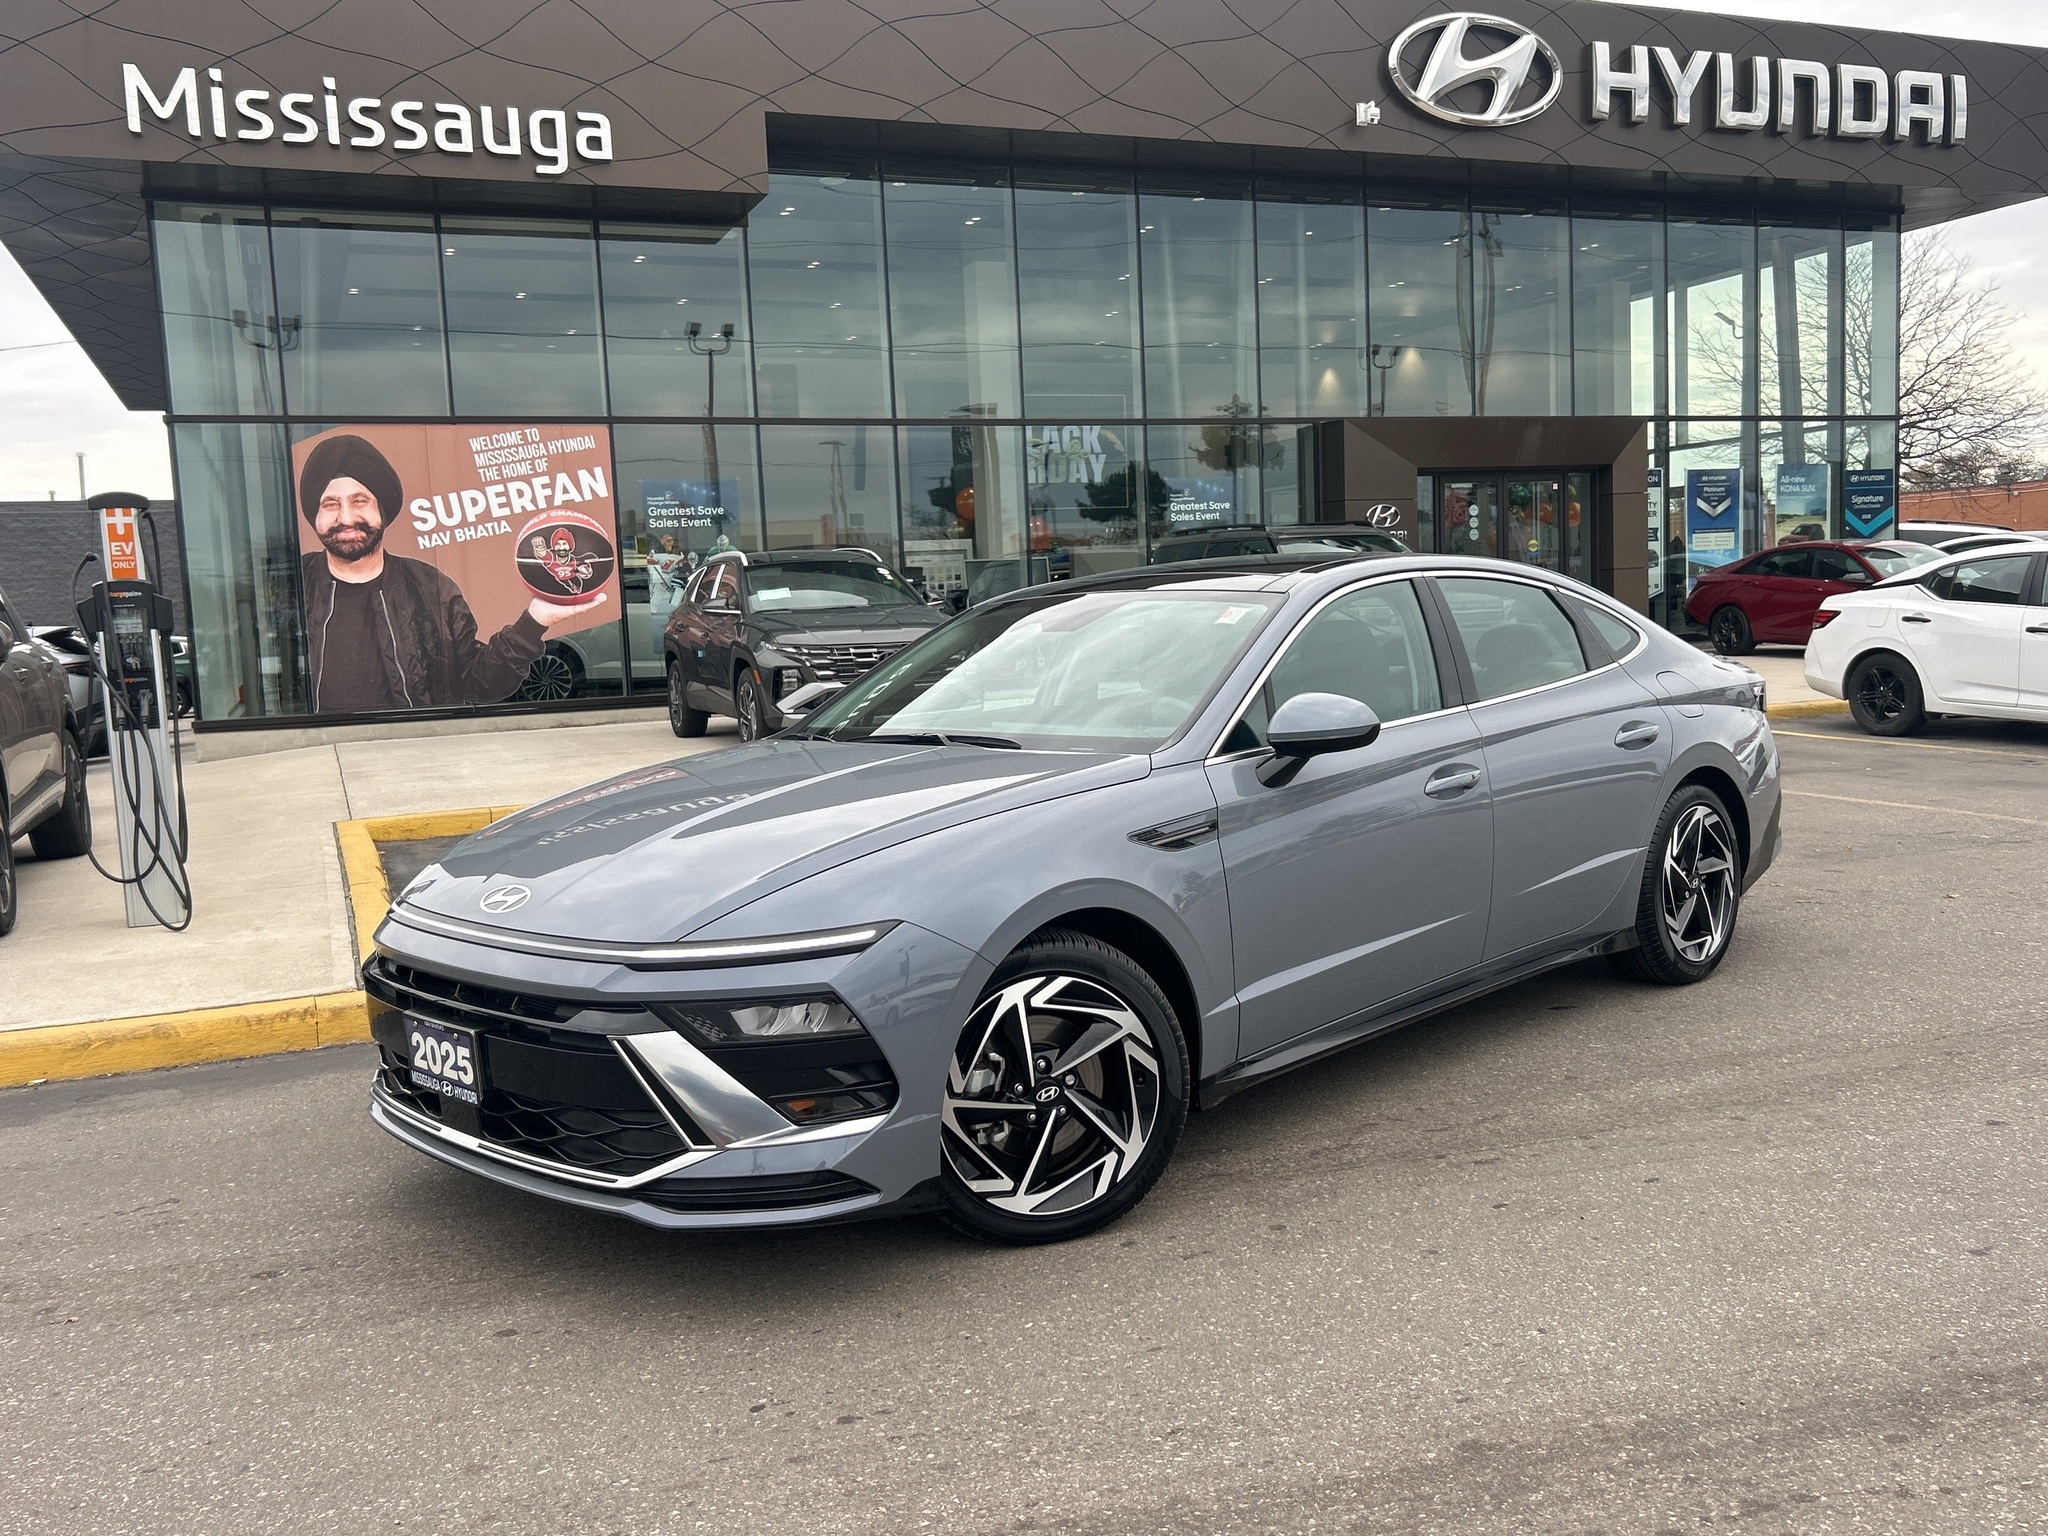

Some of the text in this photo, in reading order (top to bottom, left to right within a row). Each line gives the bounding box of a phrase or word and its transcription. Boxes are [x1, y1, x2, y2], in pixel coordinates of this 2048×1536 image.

[1591, 40, 1969, 147] HYUNDAI
[121, 62, 615, 175] Mississauga
[469, 427, 540, 452] WELCOME TO
[474, 435, 596, 468] MISSISSAUGA HYUNDAI
[478, 458, 549, 483] THE HOME OF
[1780, 484, 1800, 492] KONA
[409, 466, 609, 532] SUPERFAN
[1170, 501, 1231, 511] Greatest Save
[1851, 495, 1884, 504] Signature
[648, 506, 725, 516] Greatest Save
[1170, 511, 1220, 522] Sales Event
[649, 517, 712, 528] Sales Event
[417, 520, 513, 550] NAV BHATIA
[110, 541, 134, 555] EV
[112, 561, 136, 569] ONLY
[558, 570, 572, 578] 95
[411, 1031, 474, 1085] 2025
[411, 1069, 479, 1105] MISSISSAUGA HYUNDAI
